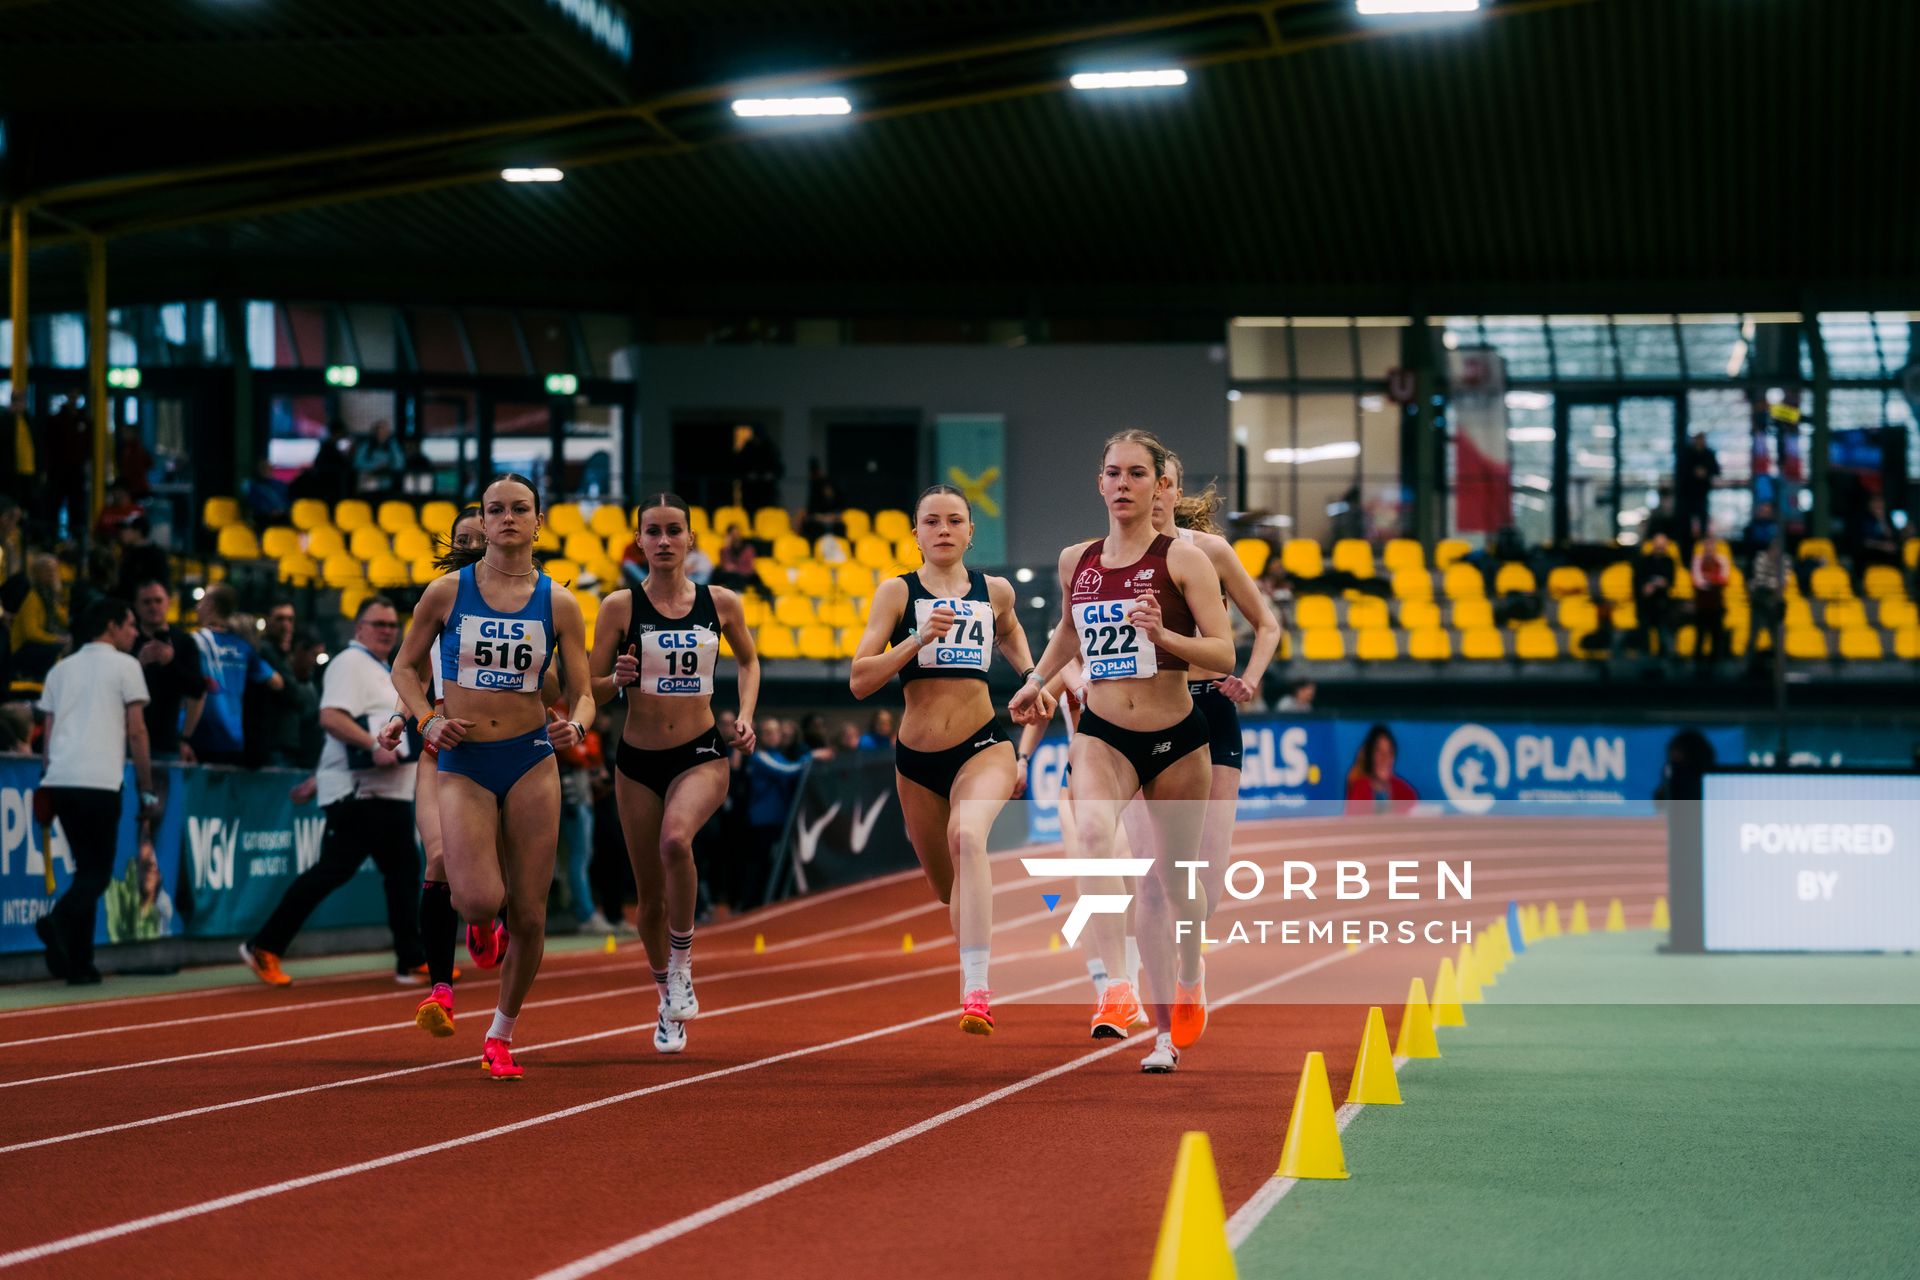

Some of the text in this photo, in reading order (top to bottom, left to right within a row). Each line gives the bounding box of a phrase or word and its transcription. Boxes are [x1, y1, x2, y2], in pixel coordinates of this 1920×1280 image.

[474, 641, 533, 671] 516
[956, 650, 981, 659] PLAN
[1085, 625, 1139, 657] 222
[665, 651, 698, 675] 19
[1107, 660, 1134, 671] PLAN
[497, 674, 522, 685] PLAN
[675, 680, 700, 688] PLAN
[1515, 735, 1626, 780] PLAN
[1, 787, 77, 876] PLA
[1740, 823, 1894, 854] POWERED
[1797, 870, 1838, 901] BY
